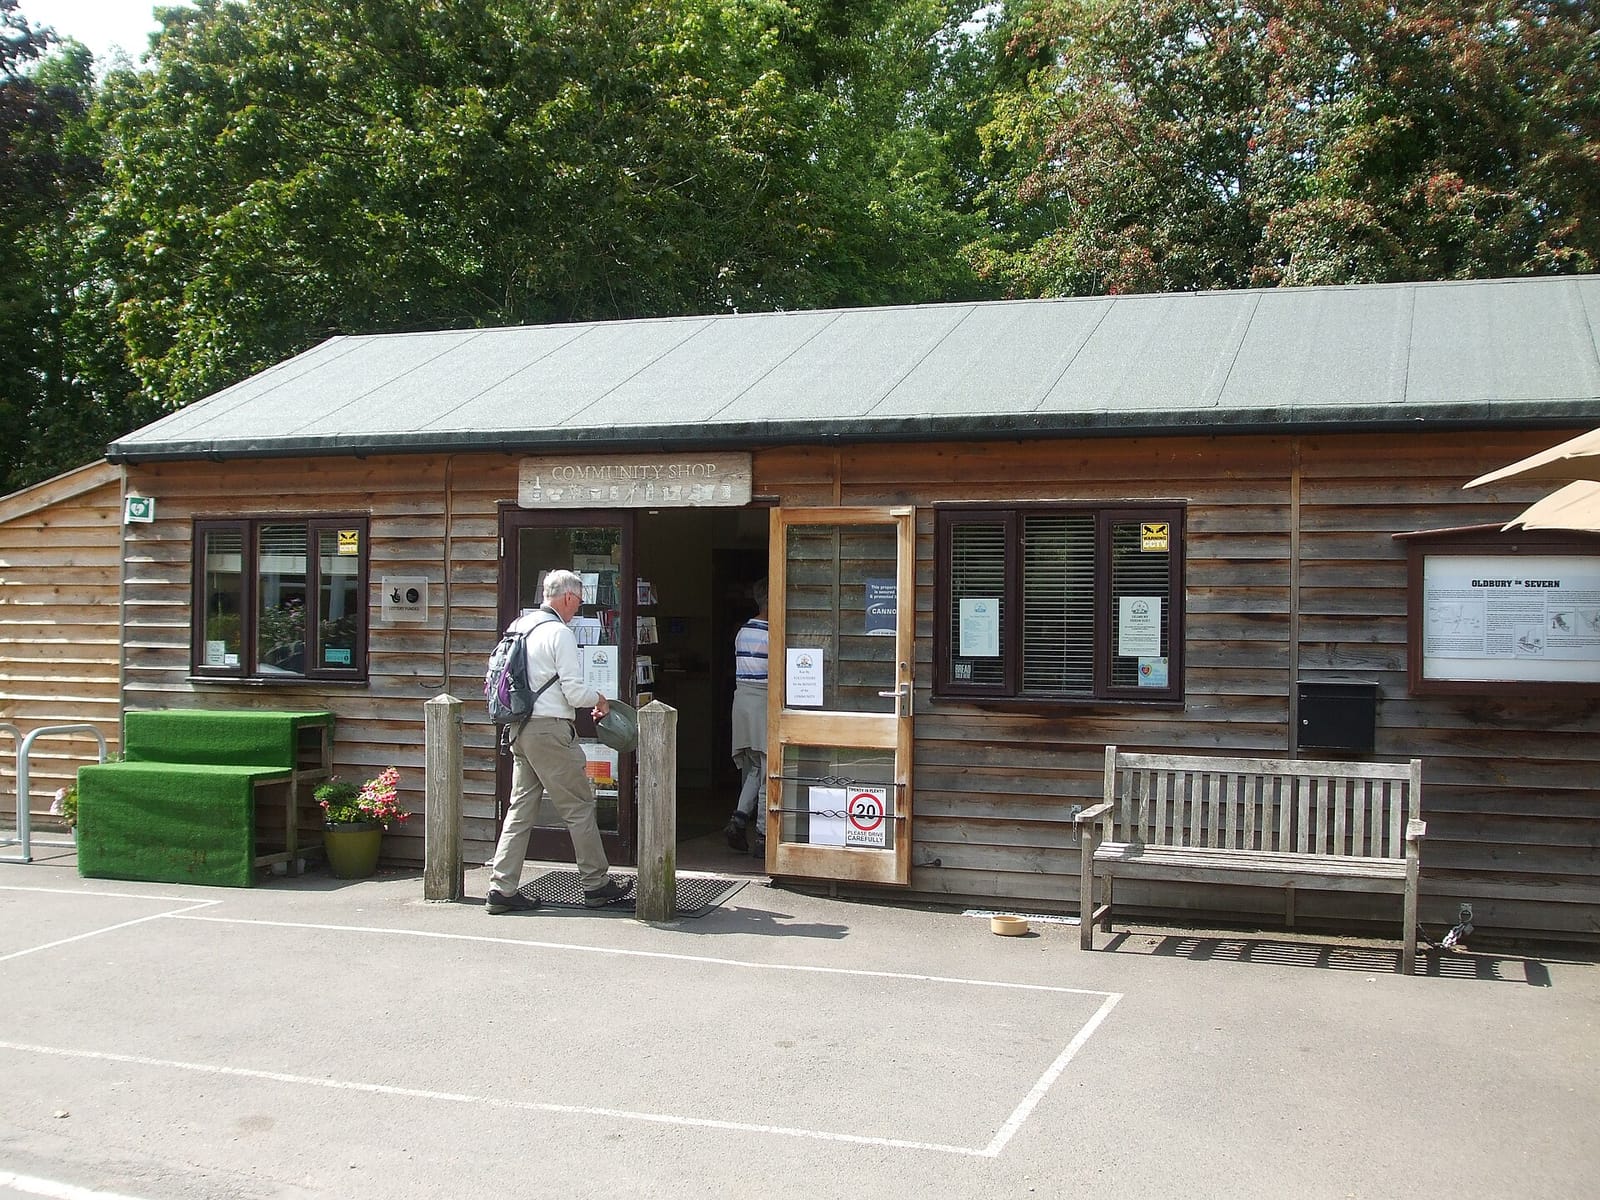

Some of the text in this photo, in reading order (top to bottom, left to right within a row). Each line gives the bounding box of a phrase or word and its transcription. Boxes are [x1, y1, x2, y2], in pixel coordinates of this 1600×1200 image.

[552, 463, 716, 481] COMMUNITY SHOP
[1524, 580, 1560, 588] SEVERN
[856, 803, 876, 819] 20
